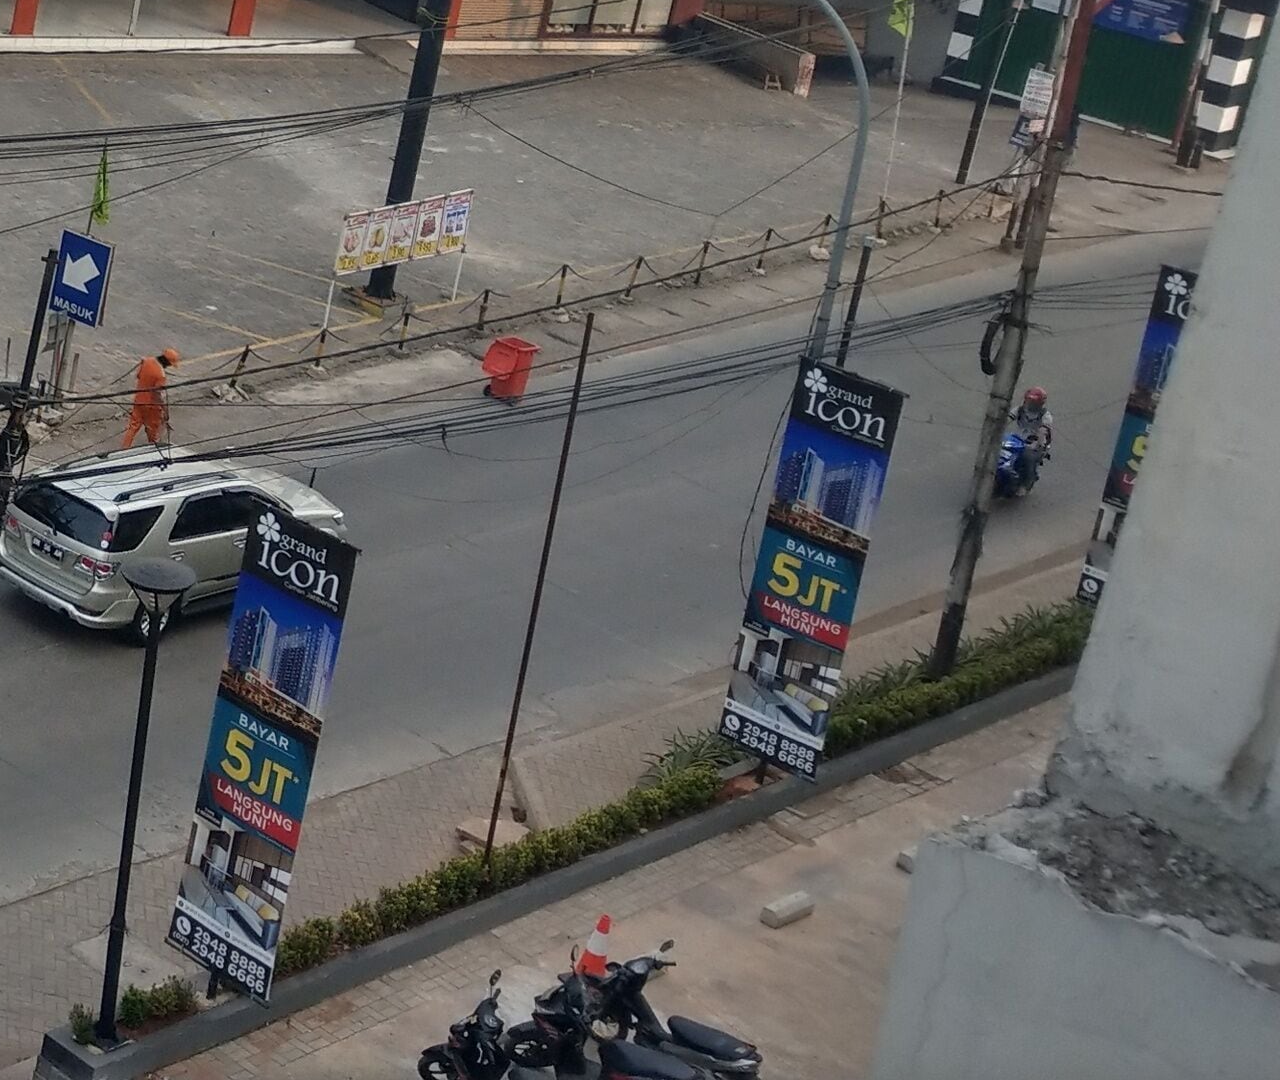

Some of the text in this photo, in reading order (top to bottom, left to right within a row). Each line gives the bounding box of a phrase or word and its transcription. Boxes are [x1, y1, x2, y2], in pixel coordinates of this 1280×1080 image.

[53, 295, 94, 322] MASUK
[805, 392, 885, 442] icon
[826, 385, 873, 409] grand
[279, 534, 328, 565] grand
[786, 538, 837, 568] BAYAR
[257, 541, 339, 605] icon
[764, 596, 841, 635] LANGSUNG
[238, 713, 289, 751] BAYAR
[743, 722, 778, 745] 2948
[780, 740, 815, 762] 8888
[741, 733, 814, 774] 2948 6666
[217, 779, 292, 832] LANGSUNG
[191, 940, 264, 994] 2948 6666
[194, 927, 227, 957] 2948
[230, 951, 265, 980] 8888
